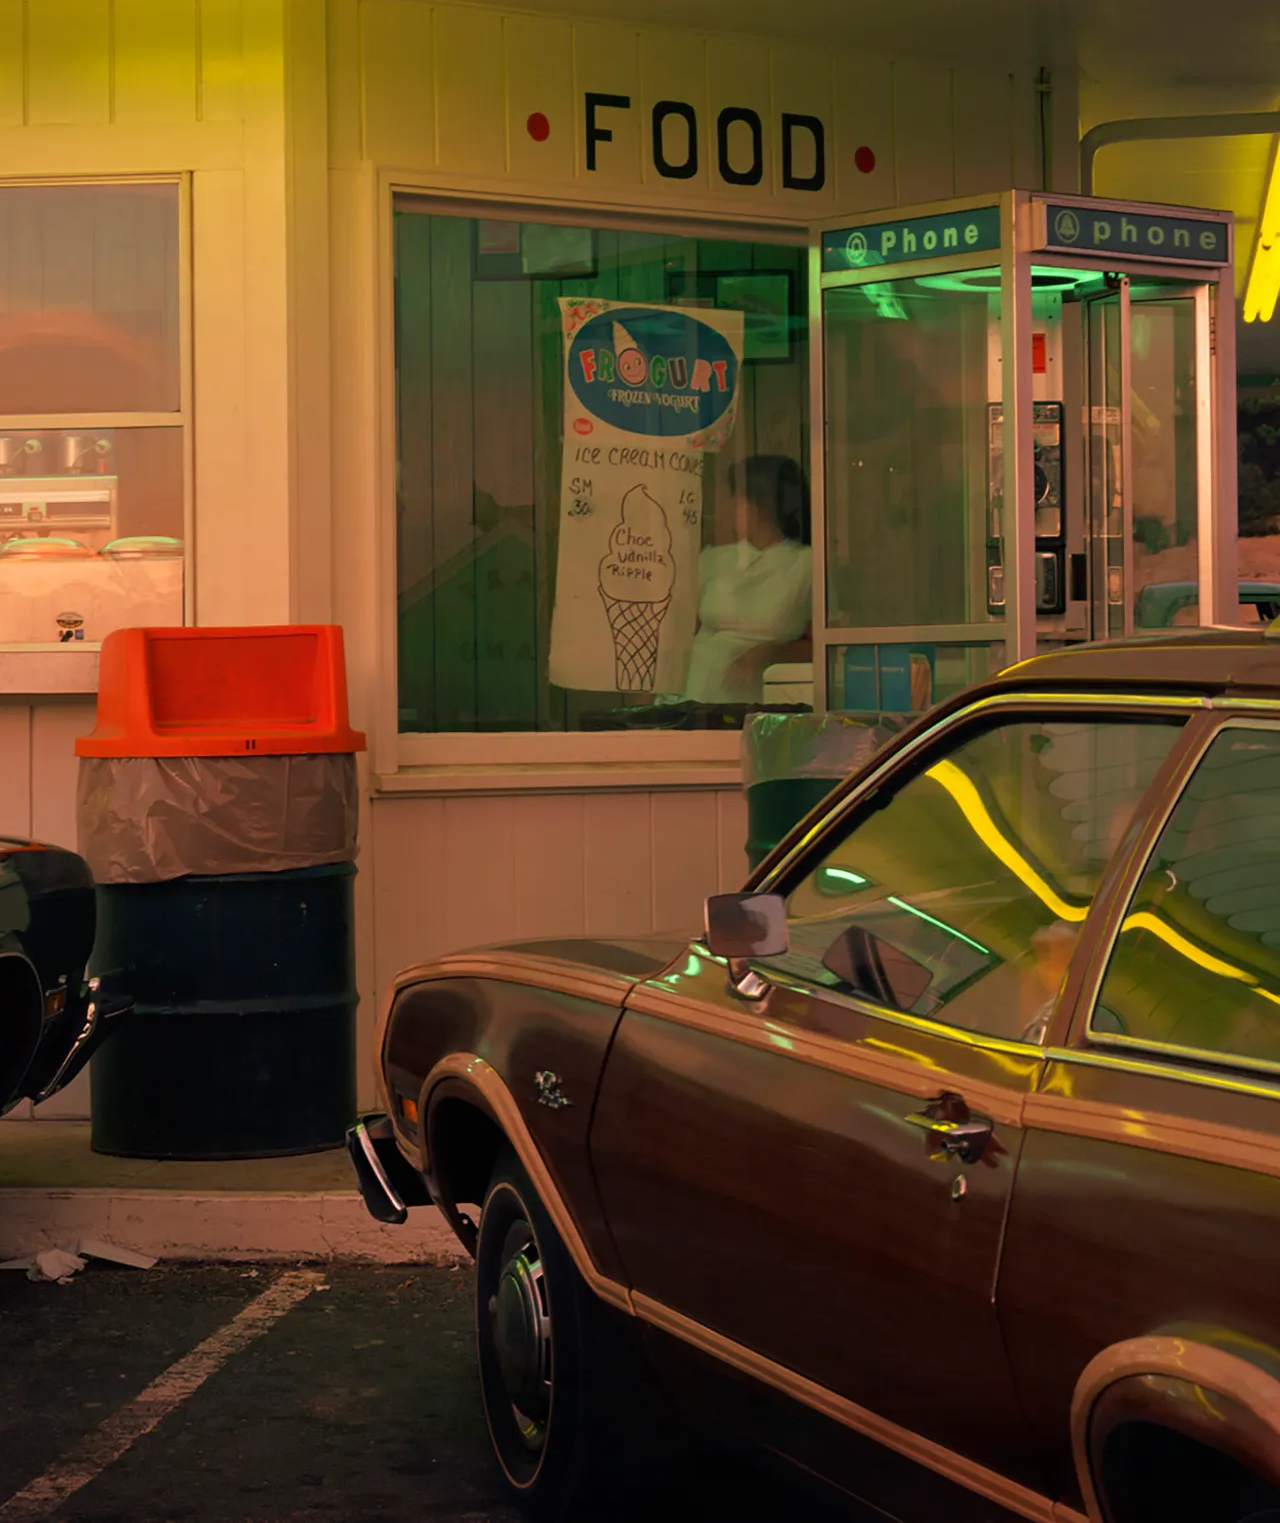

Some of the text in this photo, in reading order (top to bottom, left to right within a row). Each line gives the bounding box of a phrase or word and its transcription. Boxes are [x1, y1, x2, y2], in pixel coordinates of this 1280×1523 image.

[585, 92, 825, 192] FOOD
[579, 348, 728, 392] FROGURT
[608, 388, 701, 414] FROZEN YOGURT
[568, 478, 593, 496] SM
[615, 527, 654, 547] Choc
